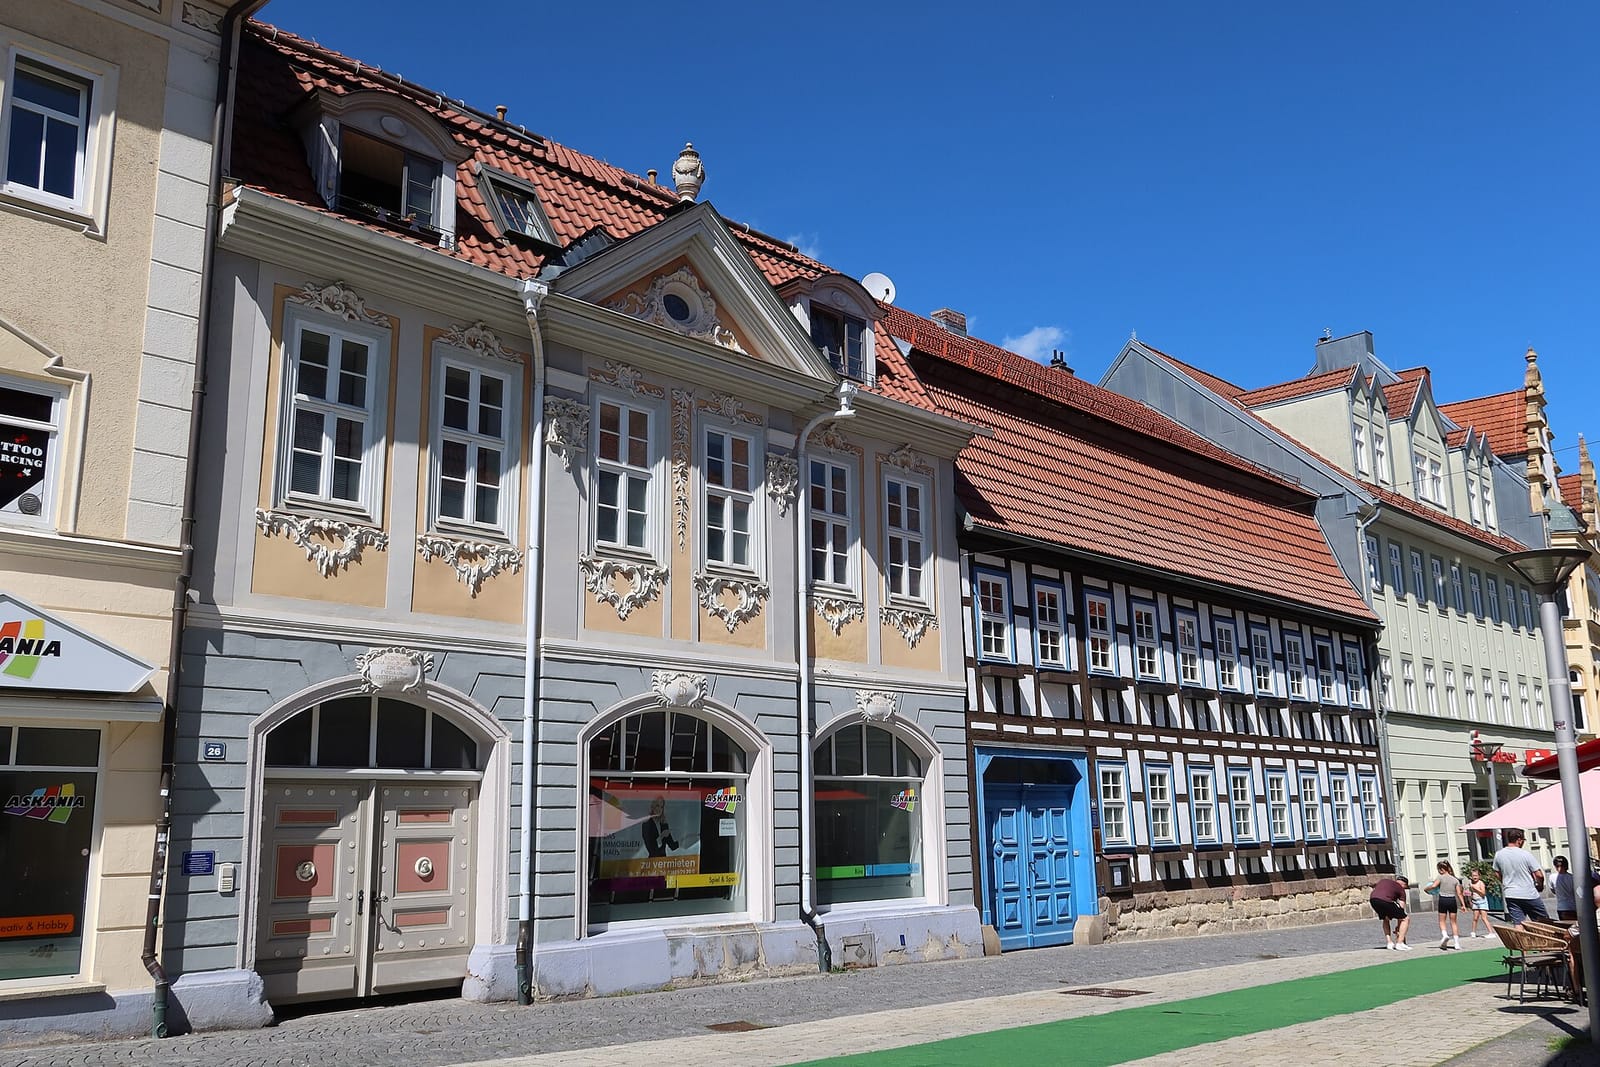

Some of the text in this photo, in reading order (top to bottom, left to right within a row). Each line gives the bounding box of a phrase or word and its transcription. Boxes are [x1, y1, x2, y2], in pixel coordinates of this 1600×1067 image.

[1, 442, 43, 457] TTOO
[1, 454, 43, 468] RCING
[0, 637, 62, 657] ANIA
[208, 747, 221, 756] 26
[5, 795, 85, 808] ASKANIA
[705, 794, 742, 803] ASKANIA
[641, 858, 696, 870] zu vermieten
[26, 921, 34, 931] &
[37, 919, 69, 931] Hobby
